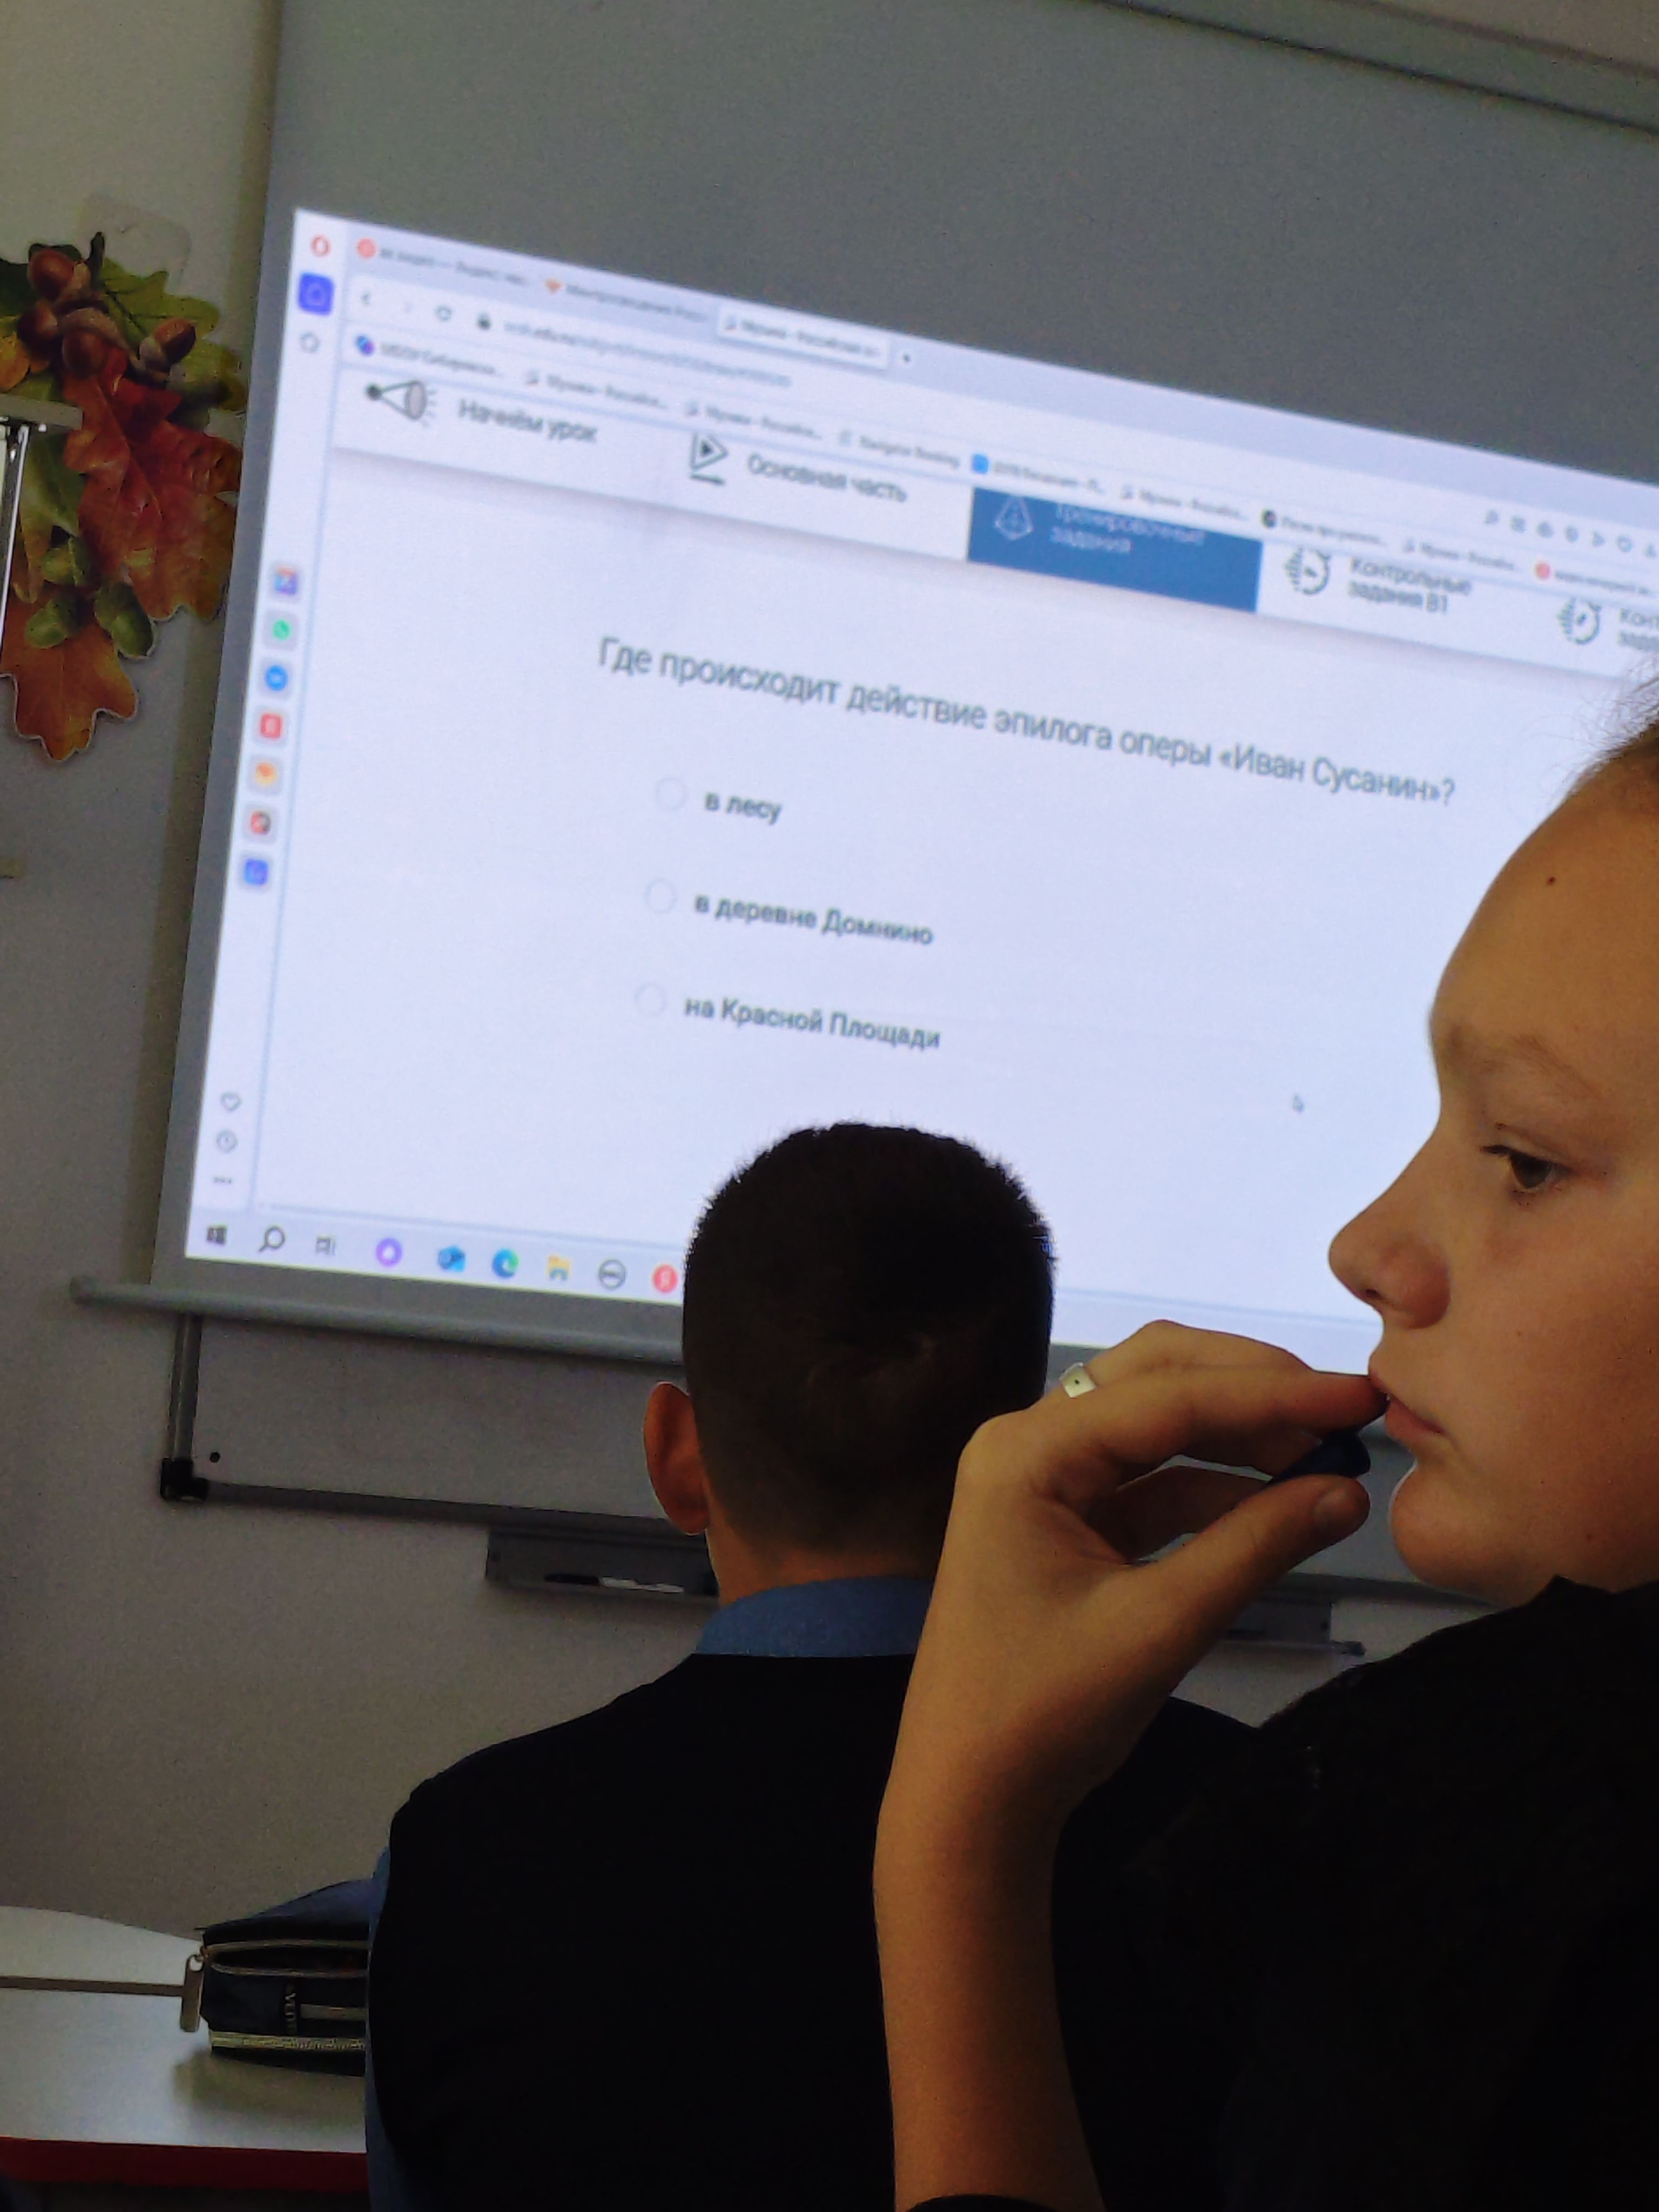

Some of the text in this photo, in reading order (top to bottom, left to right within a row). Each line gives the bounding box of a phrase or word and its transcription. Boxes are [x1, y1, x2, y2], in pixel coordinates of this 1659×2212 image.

[548, 420, 598, 442] урок
[748, 451, 846, 489] Основная
[851, 477, 908, 502] часть
[598, 636, 1456, 807] Где происходит действие эпилога оперы «Иван Сусанин»?
[705, 792, 783, 825] в лесу
[694, 894, 934, 946] в деревне Домнино
[685, 997, 941, 1051] на Красной Площади
